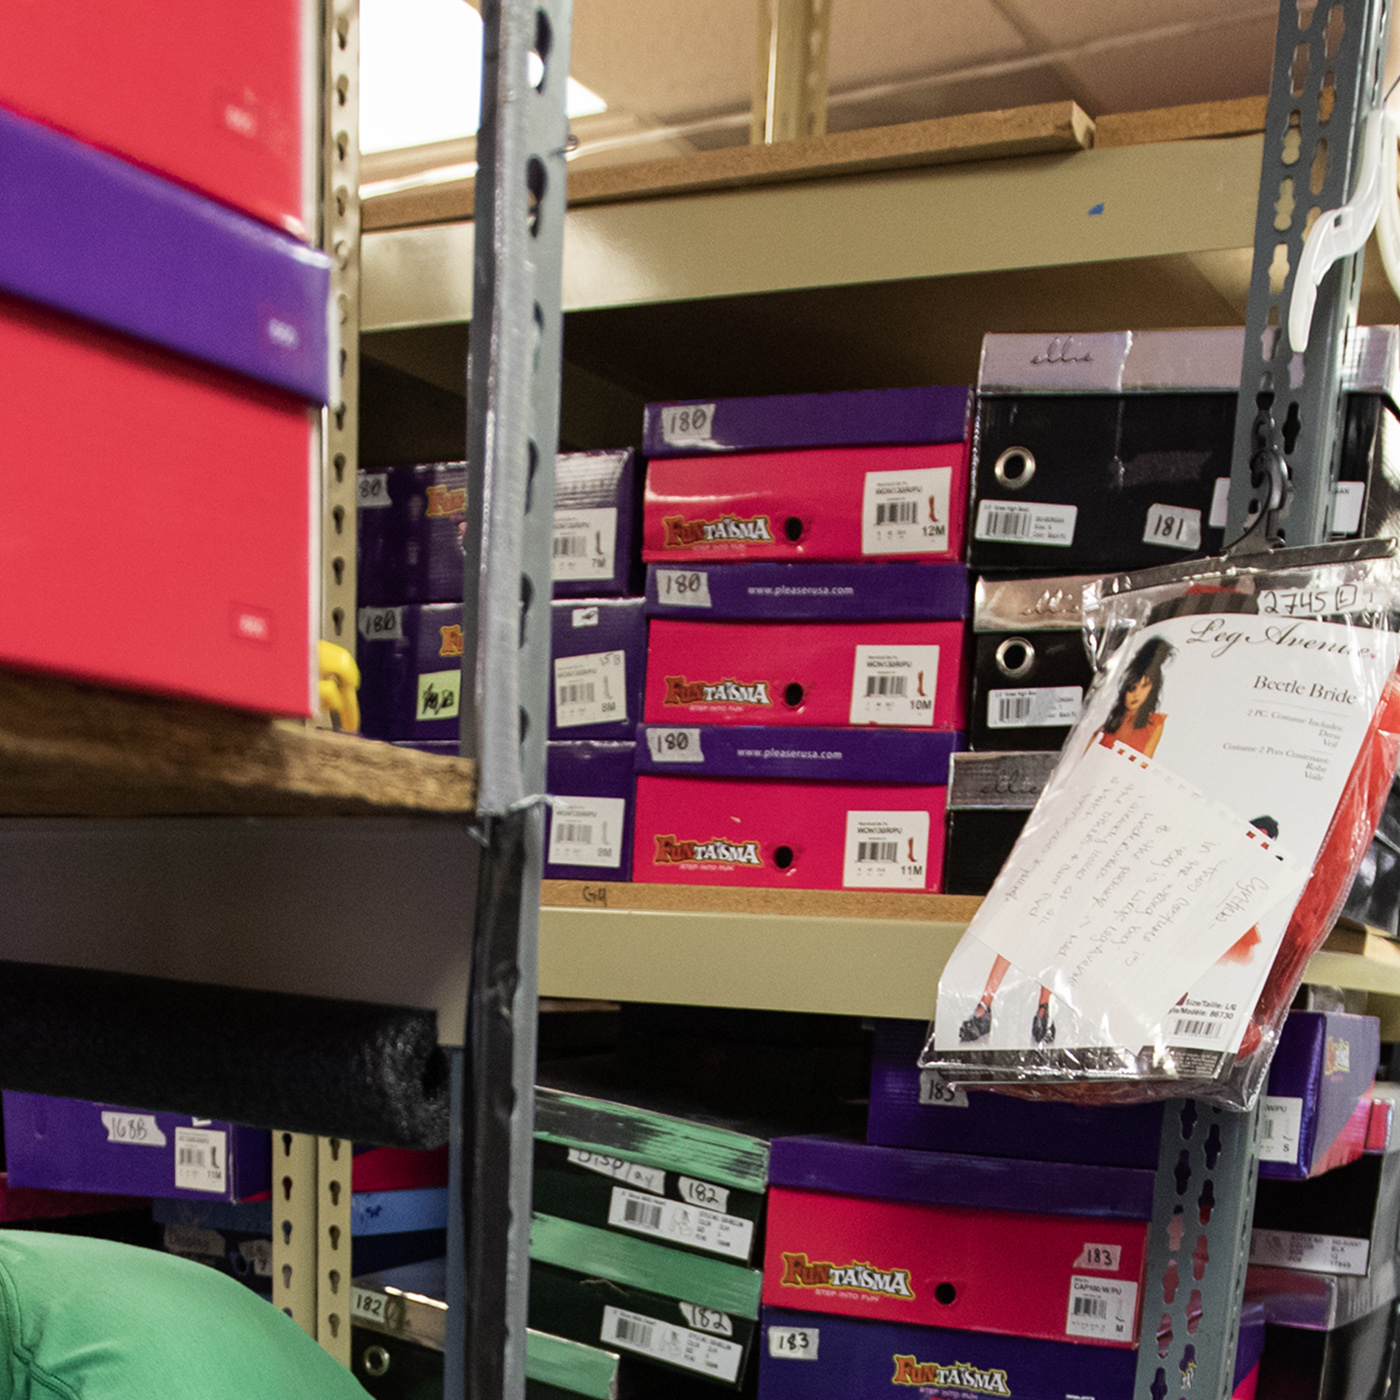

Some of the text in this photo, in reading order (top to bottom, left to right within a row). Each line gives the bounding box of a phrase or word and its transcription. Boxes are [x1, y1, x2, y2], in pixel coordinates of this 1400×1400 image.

[1030, 337, 1093, 365] ellie
[671, 408, 707, 433] 180
[922, 525, 945, 536] 12M
[1153, 514, 1185, 540] 181
[666, 573, 701, 594] 180
[747, 584, 854, 597] www.pleaserusa.com
[1264, 590, 1327, 616] 2745
[1186, 618, 1242, 658] Leg
[1253, 675, 1357, 705] Beetle Bride
[910, 700, 932, 710] 10M
[658, 732, 689, 752] 180
[737, 748, 843, 760] www.pleaserusa.com
[901, 865, 923, 876] 11M
[688, 1181, 719, 1203] 182
[1087, 1247, 1113, 1266] 183
[356, 1294, 382, 1316] 182
[692, 1305, 728, 1331] 182
[779, 1332, 810, 1351] 183
